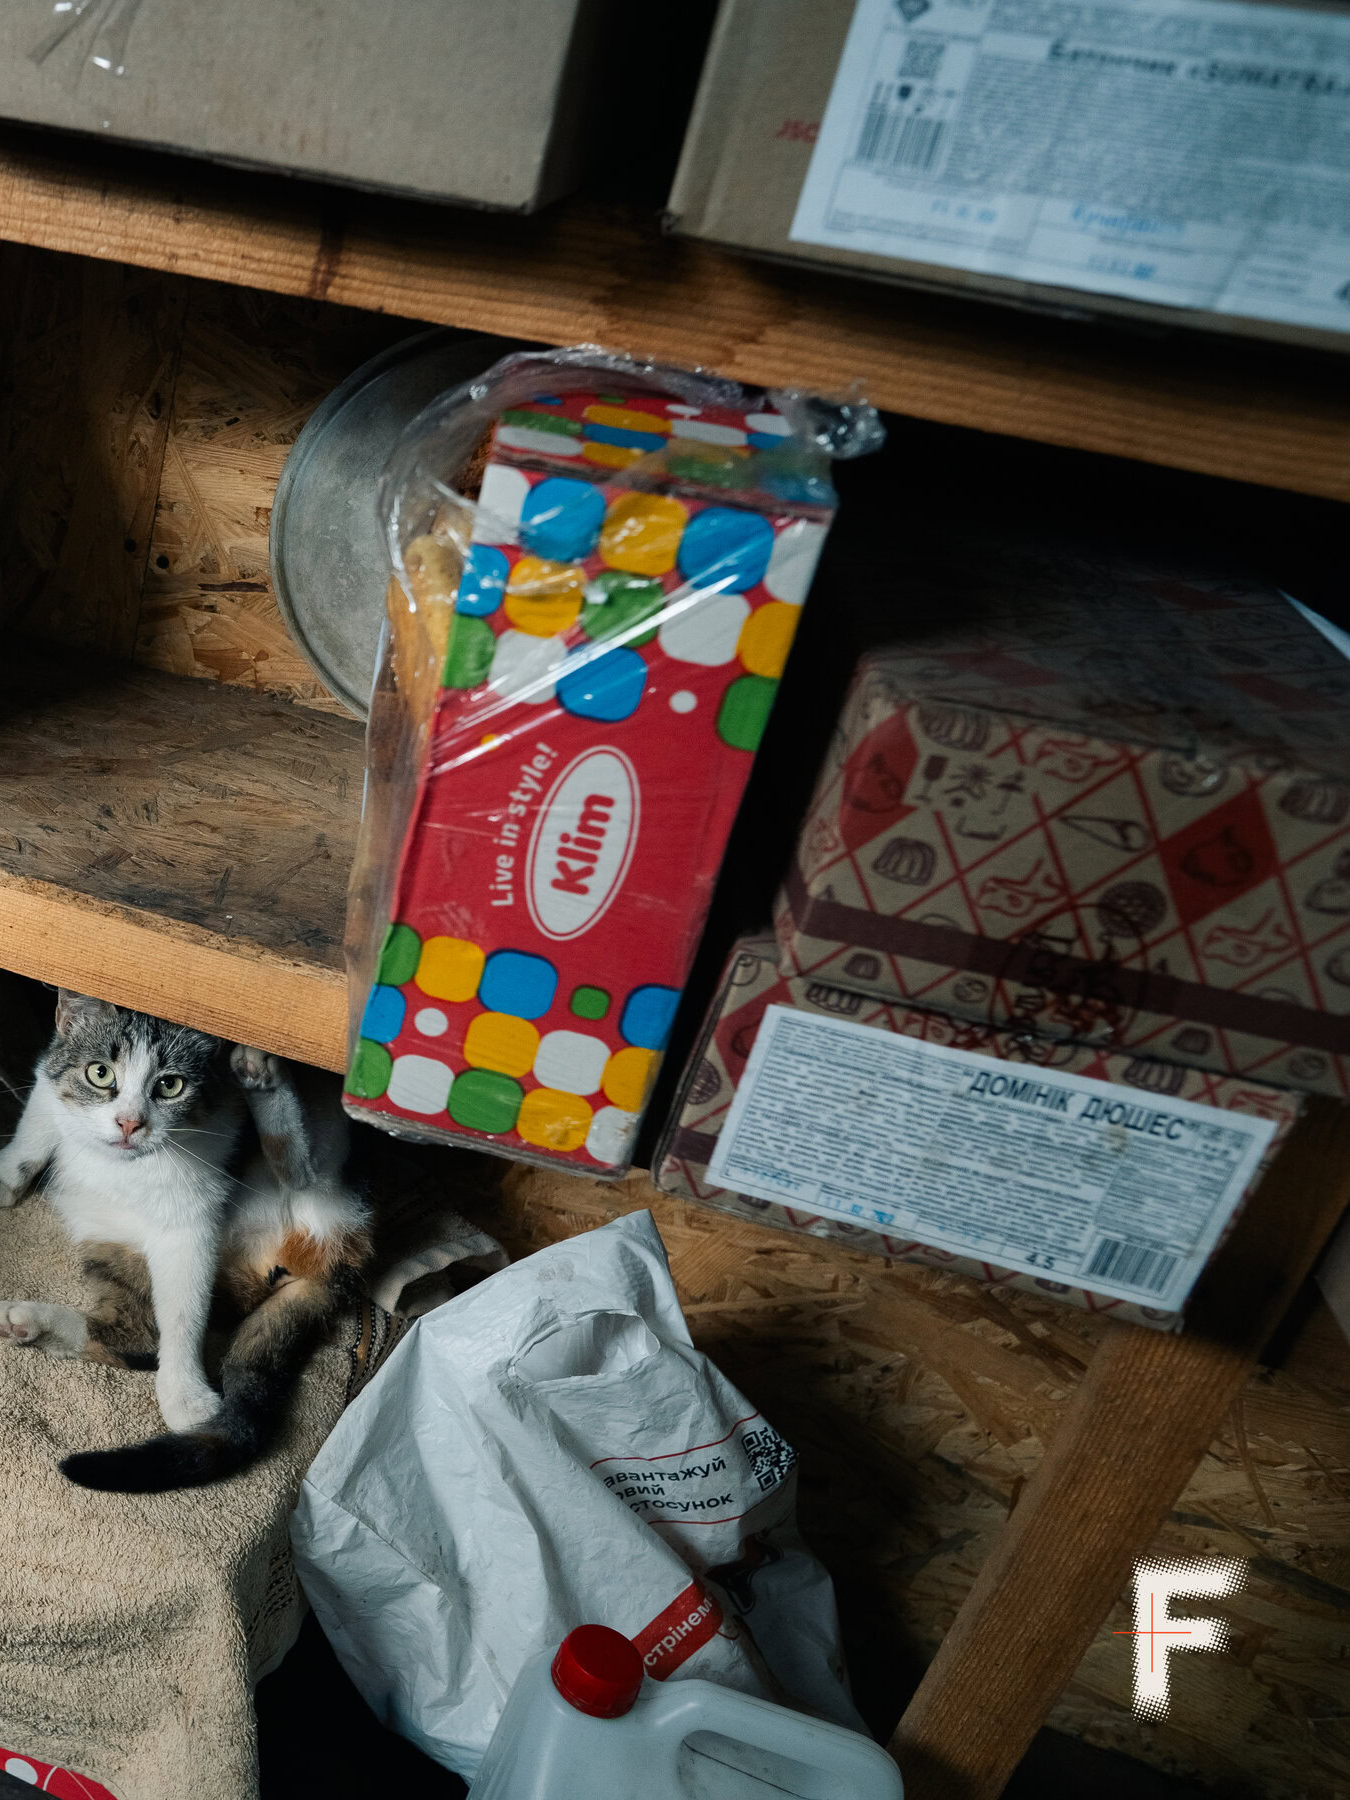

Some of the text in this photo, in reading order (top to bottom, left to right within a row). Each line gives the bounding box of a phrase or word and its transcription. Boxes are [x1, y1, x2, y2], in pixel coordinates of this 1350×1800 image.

[489, 741, 558, 907] Live in style!
[551, 793, 615, 895] Klim
[604, 1457, 727, 1489] авантажуй
[618, 1483, 665, 1501] овий
[630, 1493, 735, 1513] стосунок
[643, 1594, 716, 1668] стрінем
